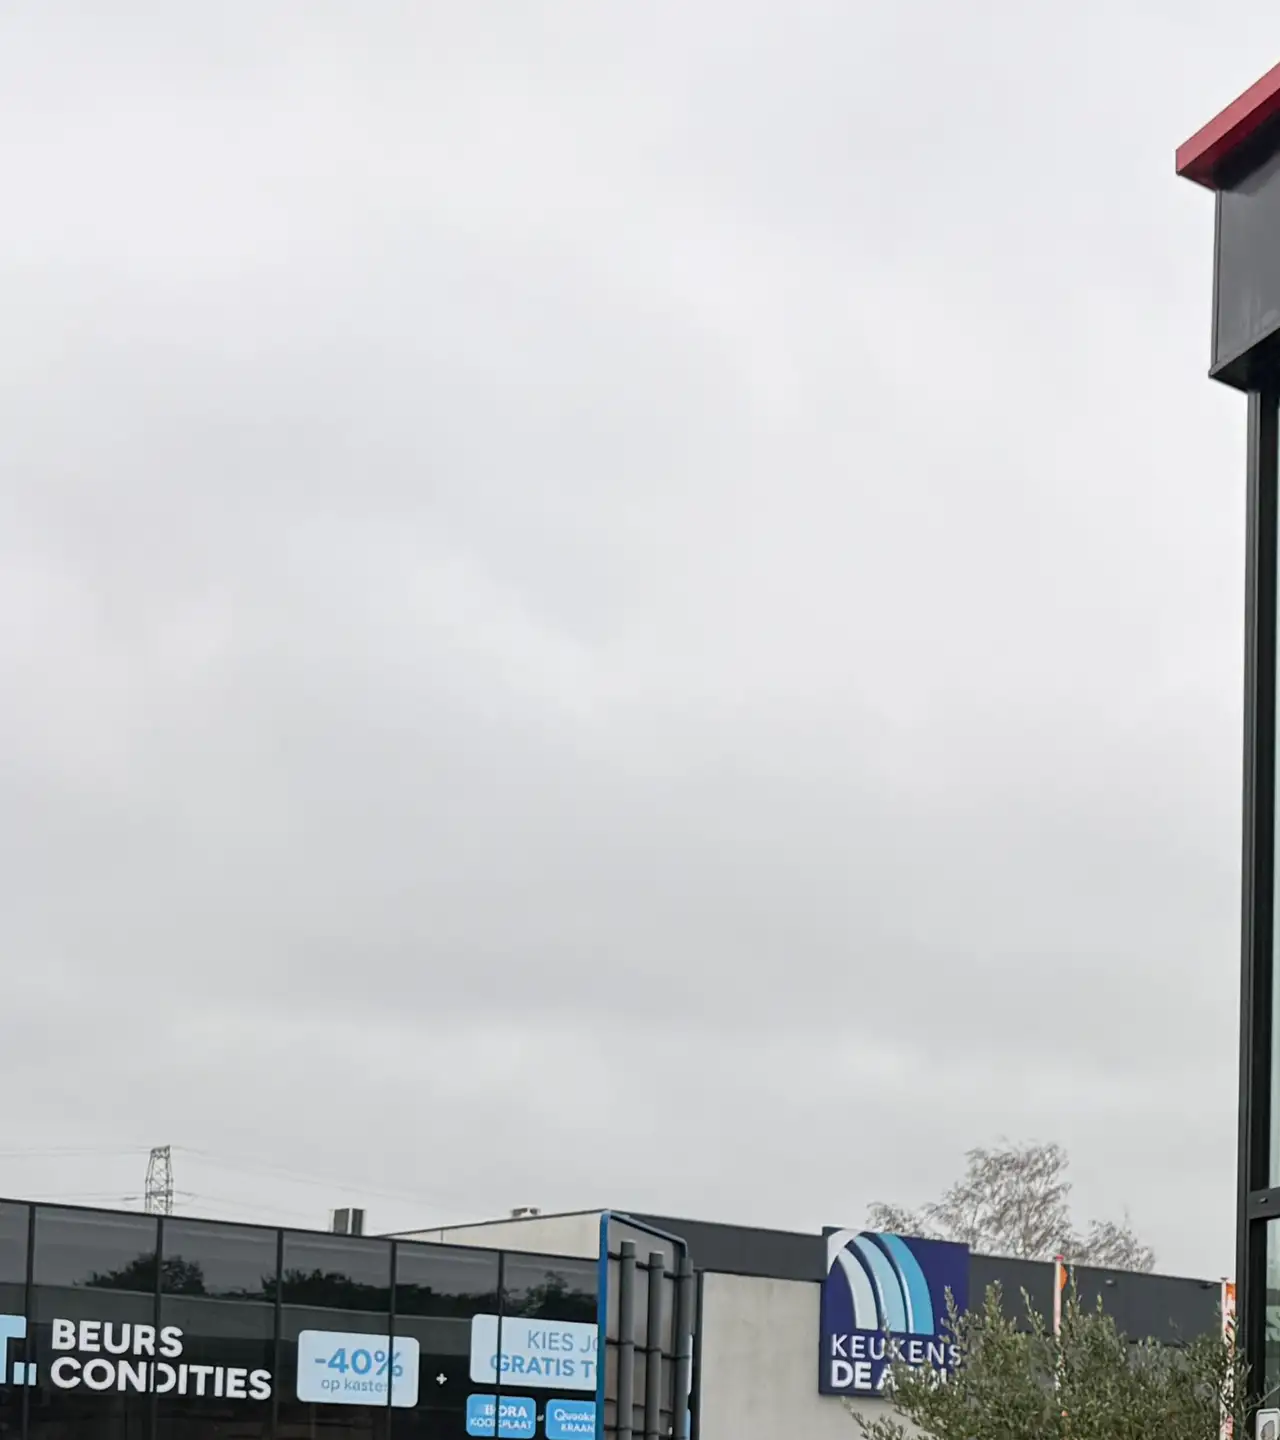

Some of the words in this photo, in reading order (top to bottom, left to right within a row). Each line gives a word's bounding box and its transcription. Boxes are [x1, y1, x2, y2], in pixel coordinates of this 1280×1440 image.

[51, 1318, 183, 1358] BEURS
[527, 1329, 574, 1352] KIES
[831, 1333, 962, 1366] KEUKENS
[314, 1347, 403, 1377] -40%
[490, 1353, 575, 1377] GRATIS
[831, 1359, 872, 1391] DE
[50, 1356, 272, 1400] CONDITIES
[321, 1379, 340, 1393] op
